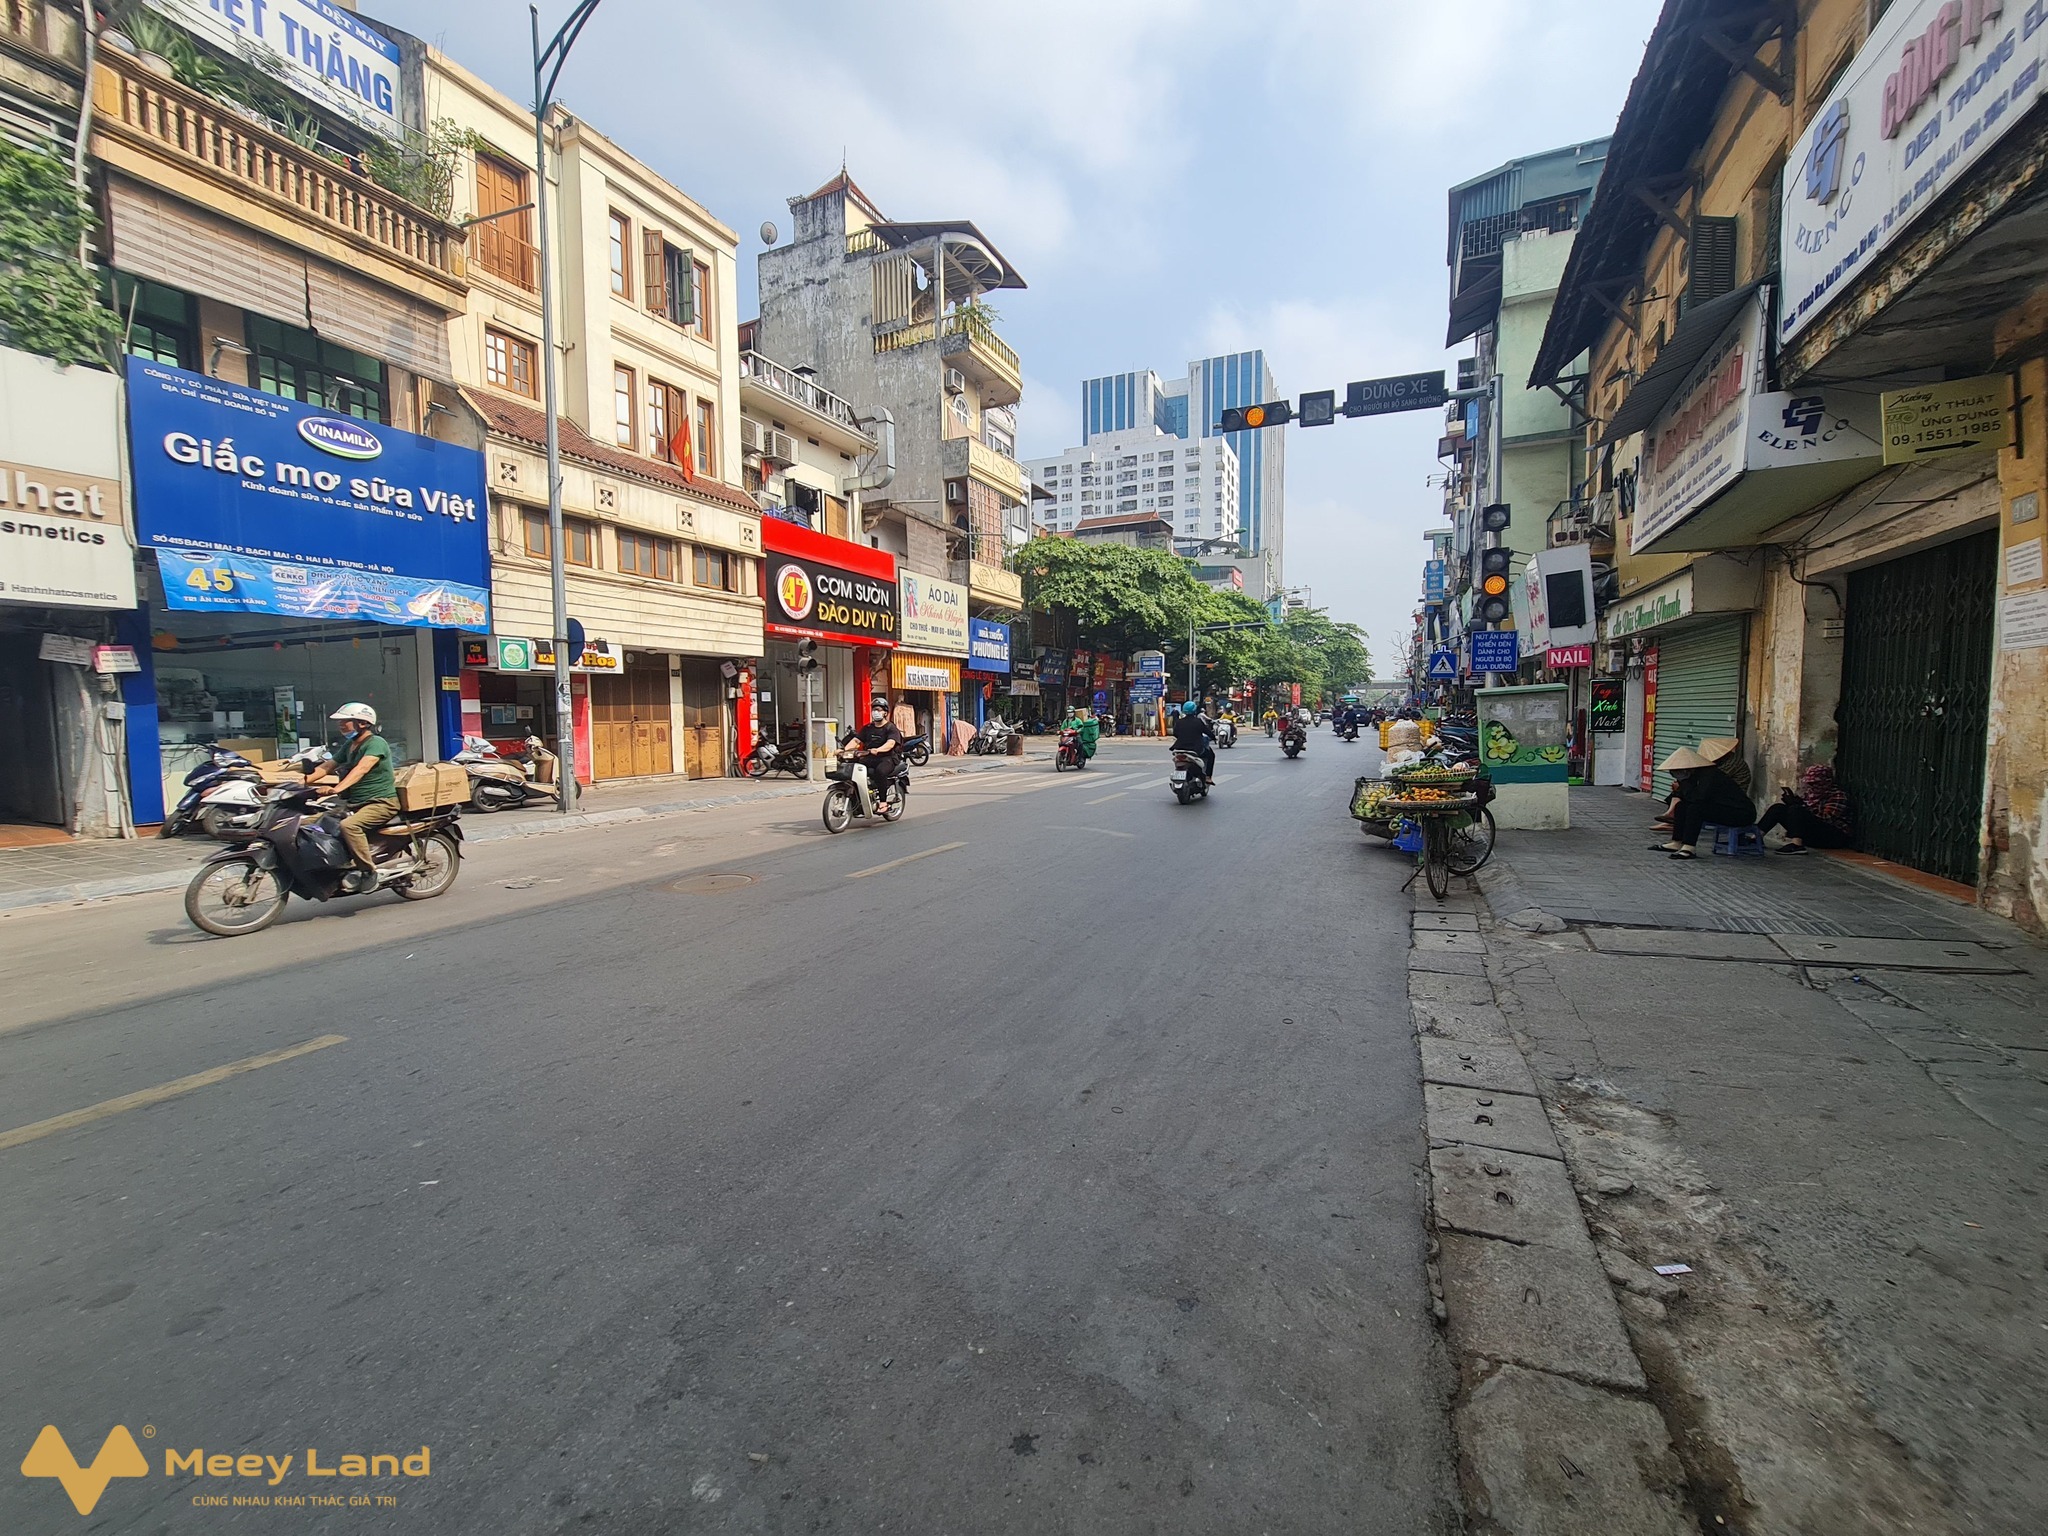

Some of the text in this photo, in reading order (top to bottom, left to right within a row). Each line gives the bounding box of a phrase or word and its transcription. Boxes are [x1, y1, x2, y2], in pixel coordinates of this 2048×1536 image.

[279, 12, 394, 115] THẮNG
[1794, 151, 1866, 254] ELENCO
[174, 375, 187, 385] TY
[1362, 378, 1429, 401] DỪNG XE
[1349, 405, 1362, 413] CHO
[1391, 399, 1400, 409] BỘ
[1401, 398, 1418, 408] SANG
[1419, 394, 1442, 404] ĐƯỜNG
[308, 422, 376, 450] VINAMILK
[1757, 418, 1850, 450] ELENCO
[1891, 420, 2002, 446] 09.1551.1985
[163, 431, 477, 522] Giấc mơ sữa Việt
[241, 480, 266, 492] Kinh
[268, 485, 299, 499] doanh
[301, 491, 320, 503] sữa
[323, 495, 334, 505] và
[336, 497, 352, 509] các
[0, 520, 105, 545] smetics
[274, 550, 290, 559] MAI
[306, 555, 321, 564] HAI
[186, 568, 234, 592] 45
[275, 572, 304, 580] KENKO
[816, 574, 889, 607] CƠM SƯỜN
[928, 584, 958, 606] ÁO DÀI
[818, 597, 895, 632] ĐÀO DUY TỪ
[1475, 632, 1488, 640] NÚT
[582, 652, 617, 668] Hoa
[1478, 646, 1495, 655] DÀNH
[1503, 655, 1513, 663] BỘ
[1551, 650, 1588, 664] NAIL
[1593, 700, 1618, 712] Xinh
[1594, 716, 1621, 727] Nail
